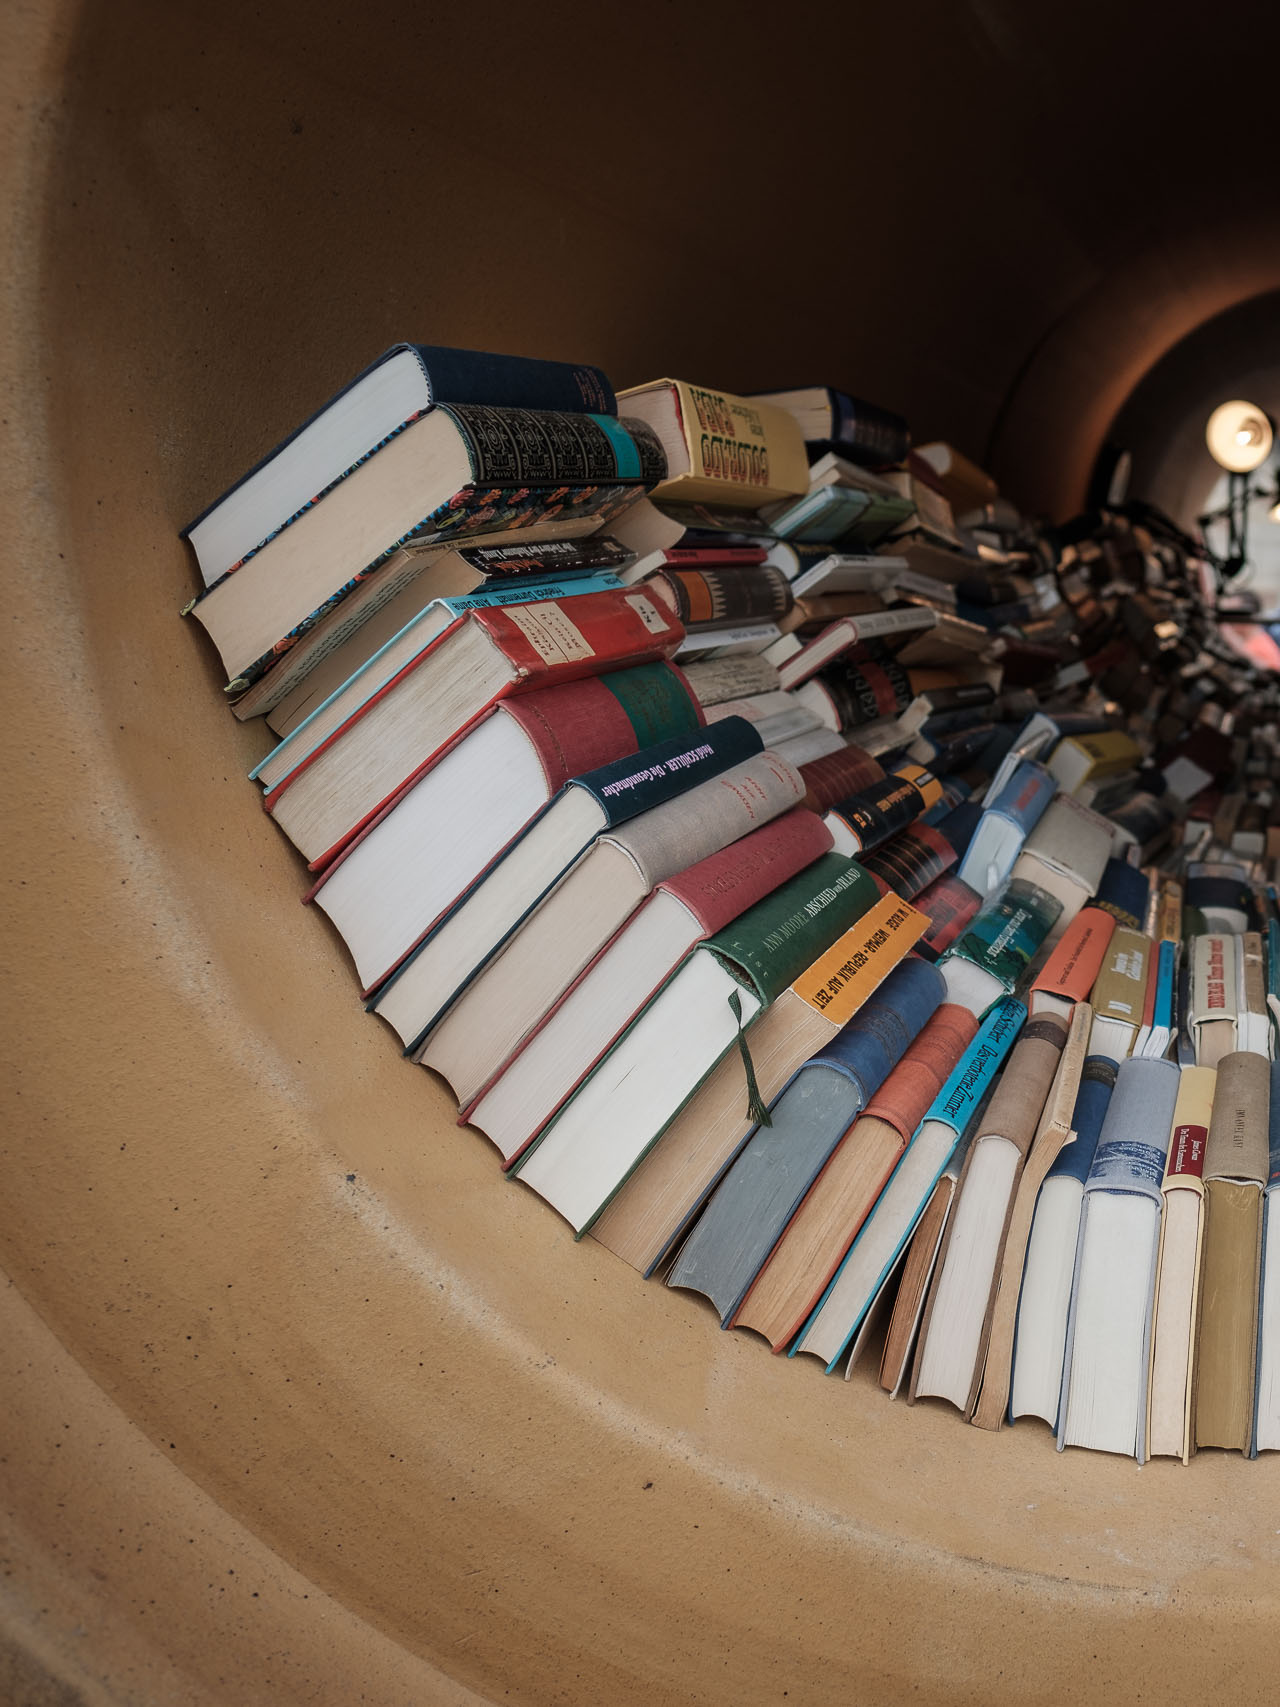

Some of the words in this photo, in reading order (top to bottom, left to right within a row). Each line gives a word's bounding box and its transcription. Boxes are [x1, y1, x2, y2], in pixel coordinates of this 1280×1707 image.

[701, 433, 769, 486] COLORADO
[665, 750, 700, 771] SCHÜLLER
[694, 743, 713, 759] Heidi
[601, 768, 654, 796] Gesundmacher
[649, 764, 666, 777] Die
[761, 931, 784, 952] ANN
[777, 910, 809, 939] MOORE
[802, 886, 838, 917] ABSCHIED
[835, 866, 861, 889] IRLAND
[884, 912, 904, 931] RUGE
[863, 928, 890, 953] WEIMAR
[836, 950, 868, 982] REPUBLIK
[824, 975, 844, 995] AUF
[811, 988, 833, 1009] ZEIT
[986, 1013, 1016, 1044] Schubert
[977, 1043, 998, 1059] Das
[959, 1055, 986, 1089] verbotene
[942, 1084, 974, 1118] Zimmer
